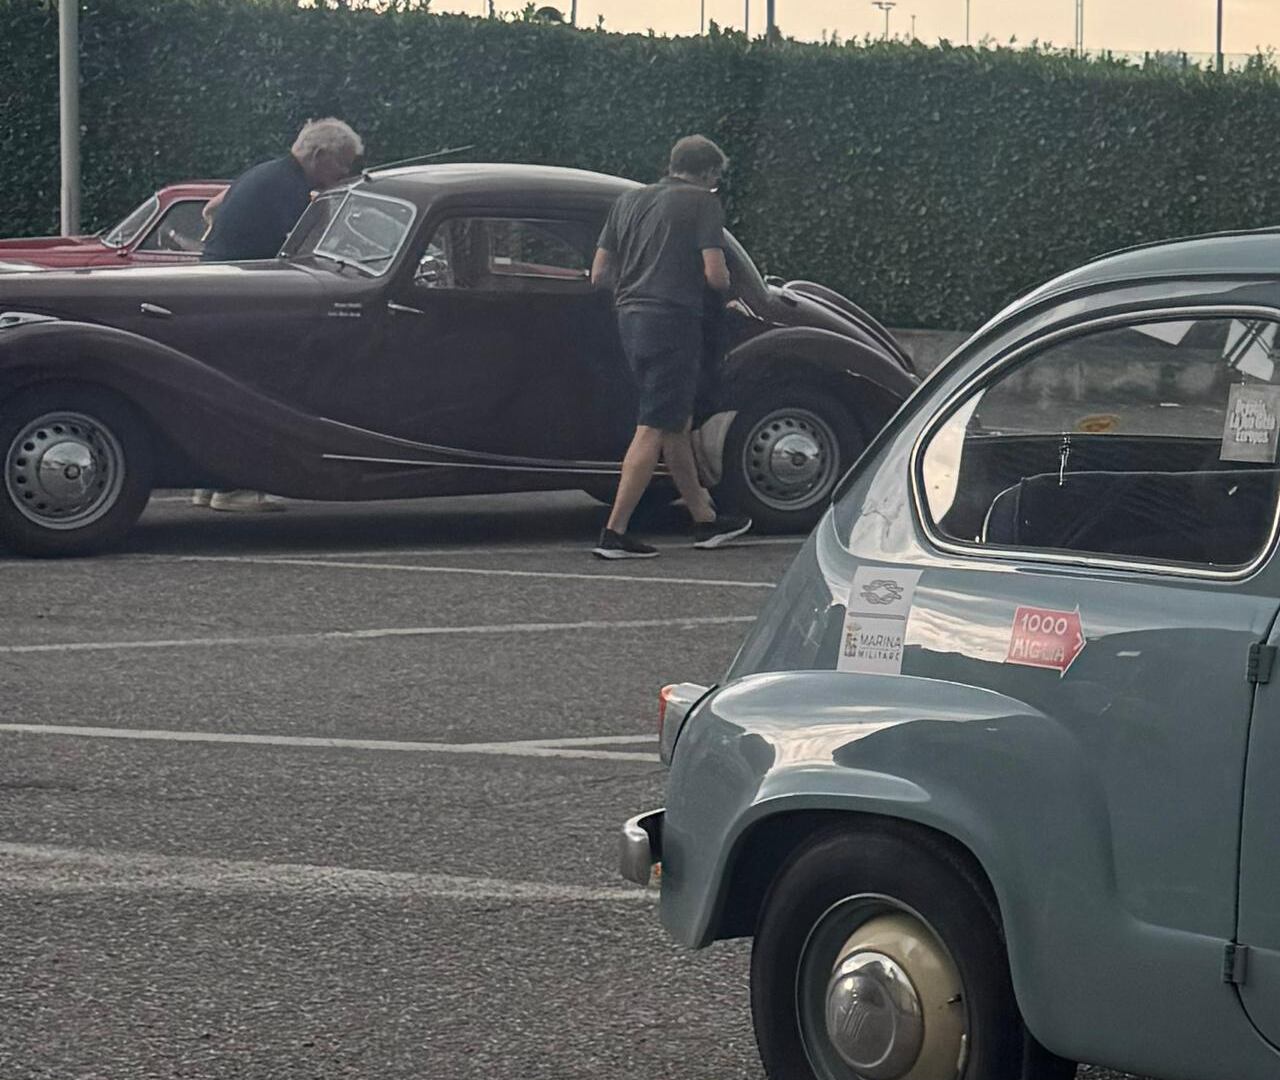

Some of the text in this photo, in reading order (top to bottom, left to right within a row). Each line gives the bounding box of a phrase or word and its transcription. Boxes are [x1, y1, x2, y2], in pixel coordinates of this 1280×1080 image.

[1022, 613, 1067, 635] 1000
[860, 633, 900, 648] MARINA
[858, 650, 900, 660] MILITARE
